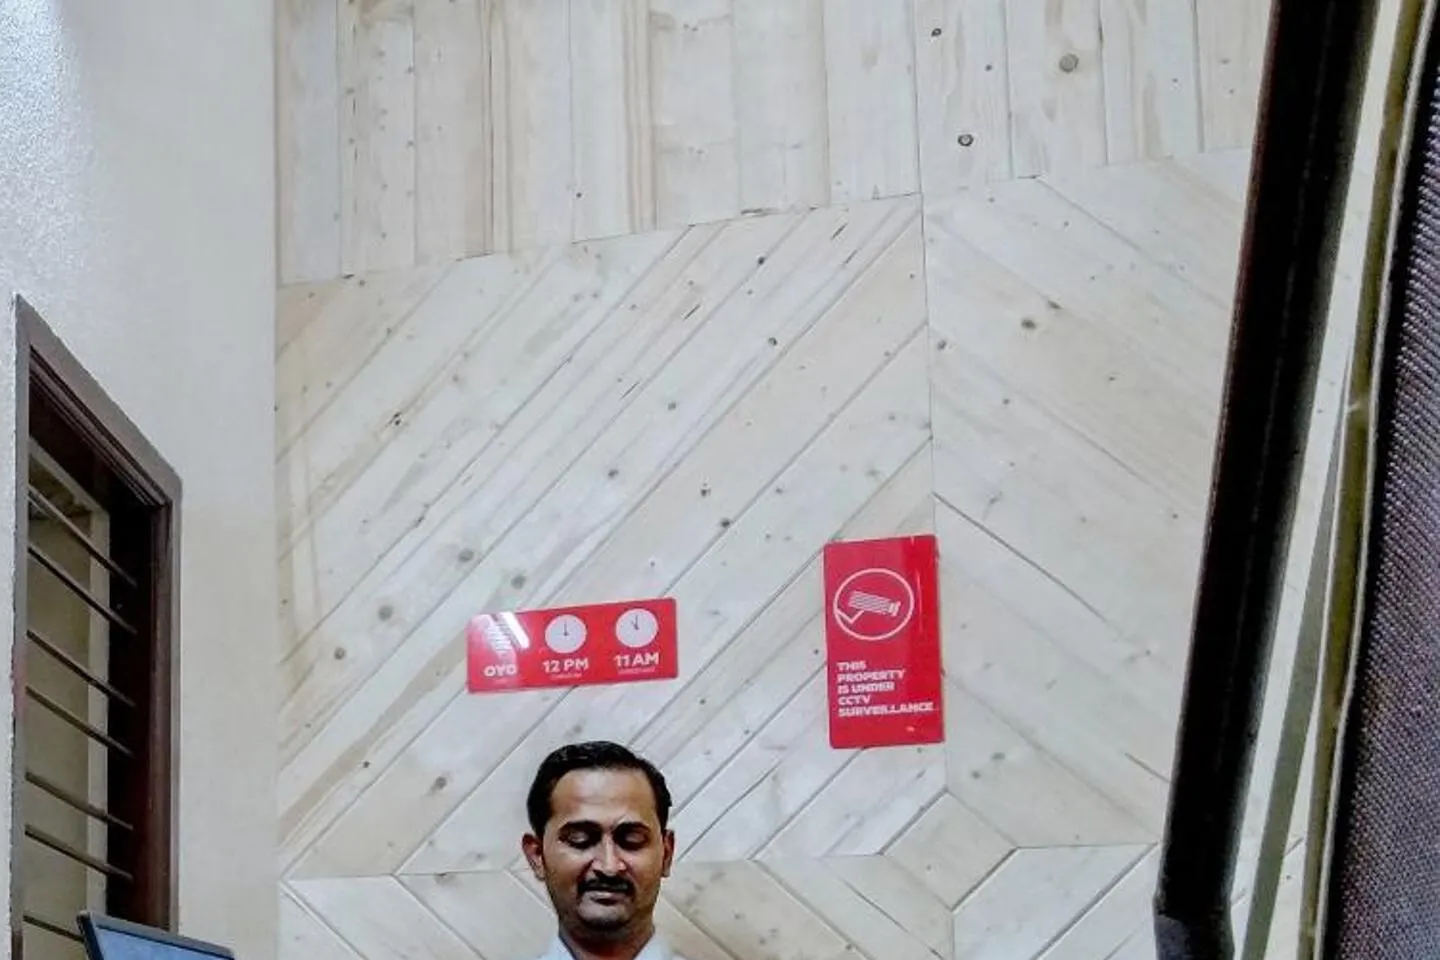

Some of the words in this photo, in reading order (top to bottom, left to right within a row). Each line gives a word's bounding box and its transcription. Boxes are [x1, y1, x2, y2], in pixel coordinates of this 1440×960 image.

[543, 660, 560, 673] 12
[563, 658, 590, 672] PM
[614, 655, 631, 668] 11
[632, 652, 660, 667] AM
[837, 660, 866, 671] THIS
[484, 664, 517, 677] OYO
[837, 668, 906, 683] PROPERTY
[838, 685, 850, 694] IS
[851, 681, 895, 693] UNDER
[838, 694, 871, 706] CCTV
[838, 702, 935, 717] SURVEILLANCE
